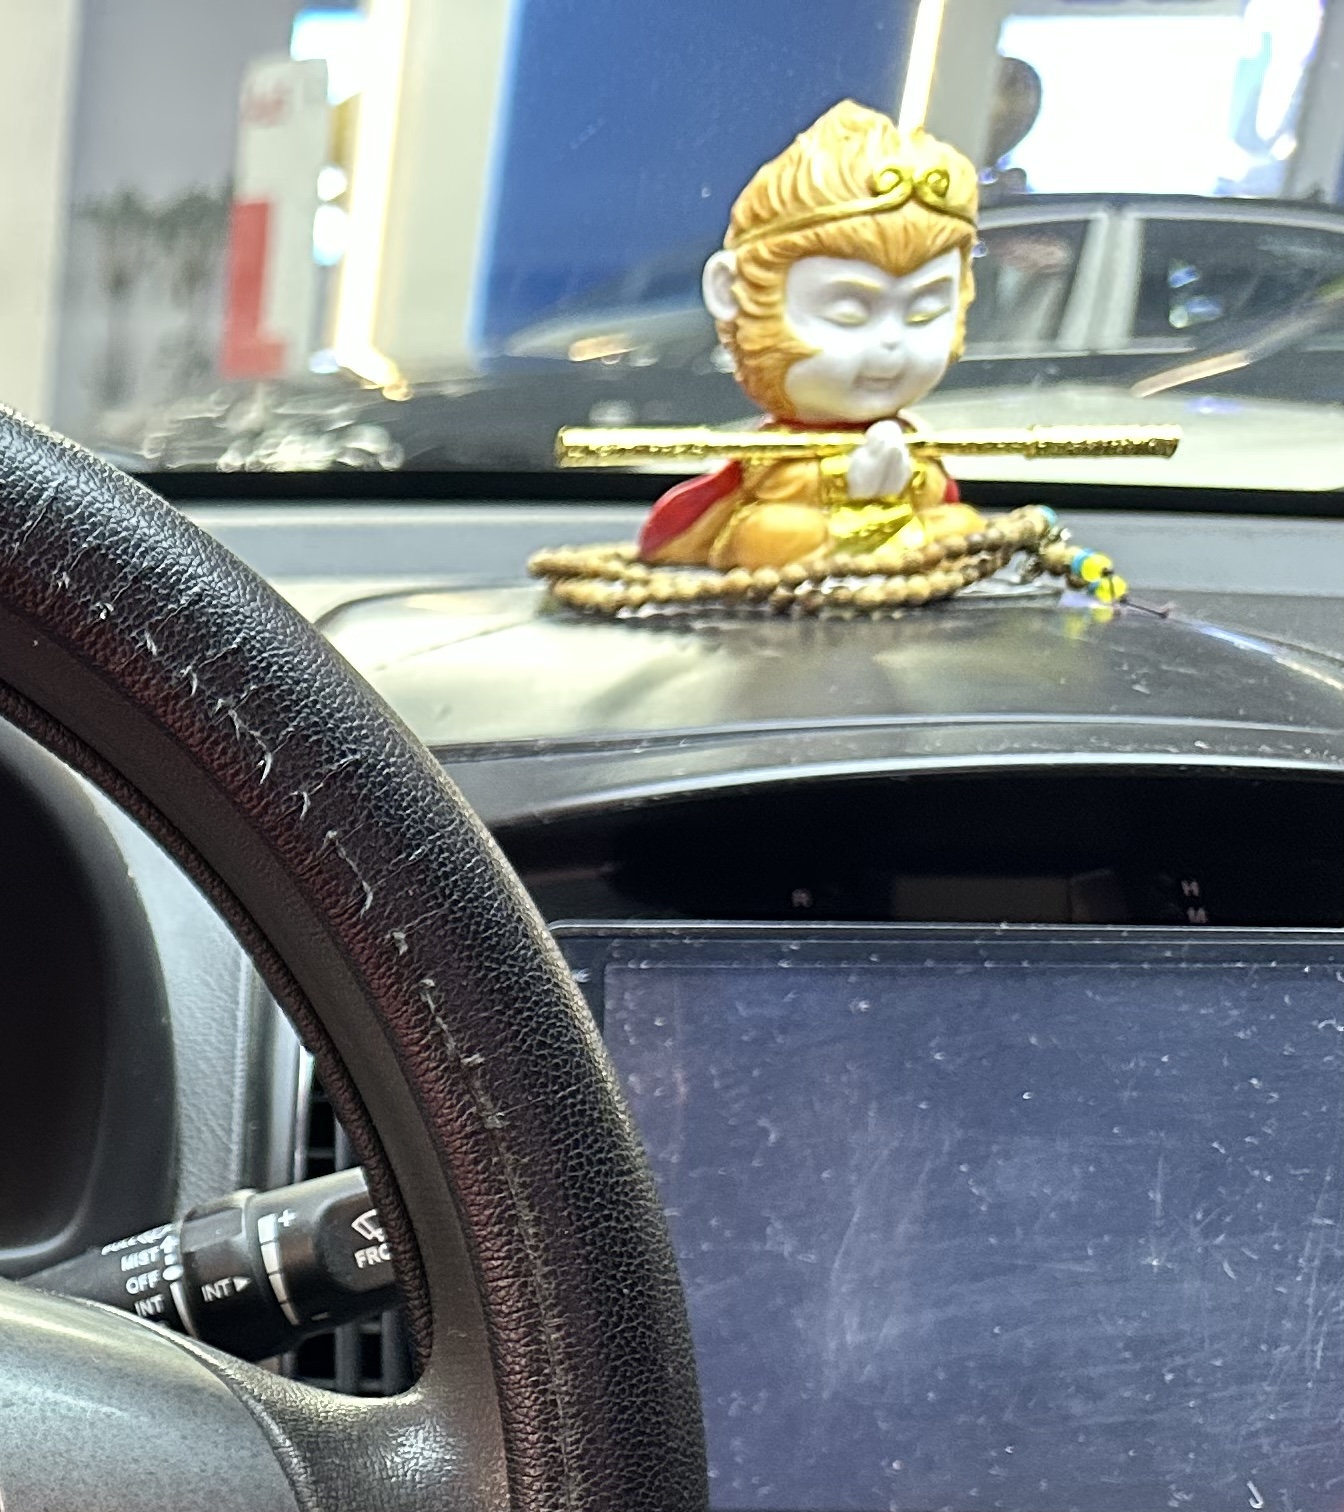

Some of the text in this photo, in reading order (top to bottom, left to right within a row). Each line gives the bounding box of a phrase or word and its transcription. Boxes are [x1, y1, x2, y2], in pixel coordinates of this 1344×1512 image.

[120, 1245, 160, 1272] MIST
[125, 1269, 161, 1295] OFF
[201, 1275, 234, 1303] INT
[134, 1294, 164, 1318] INT
